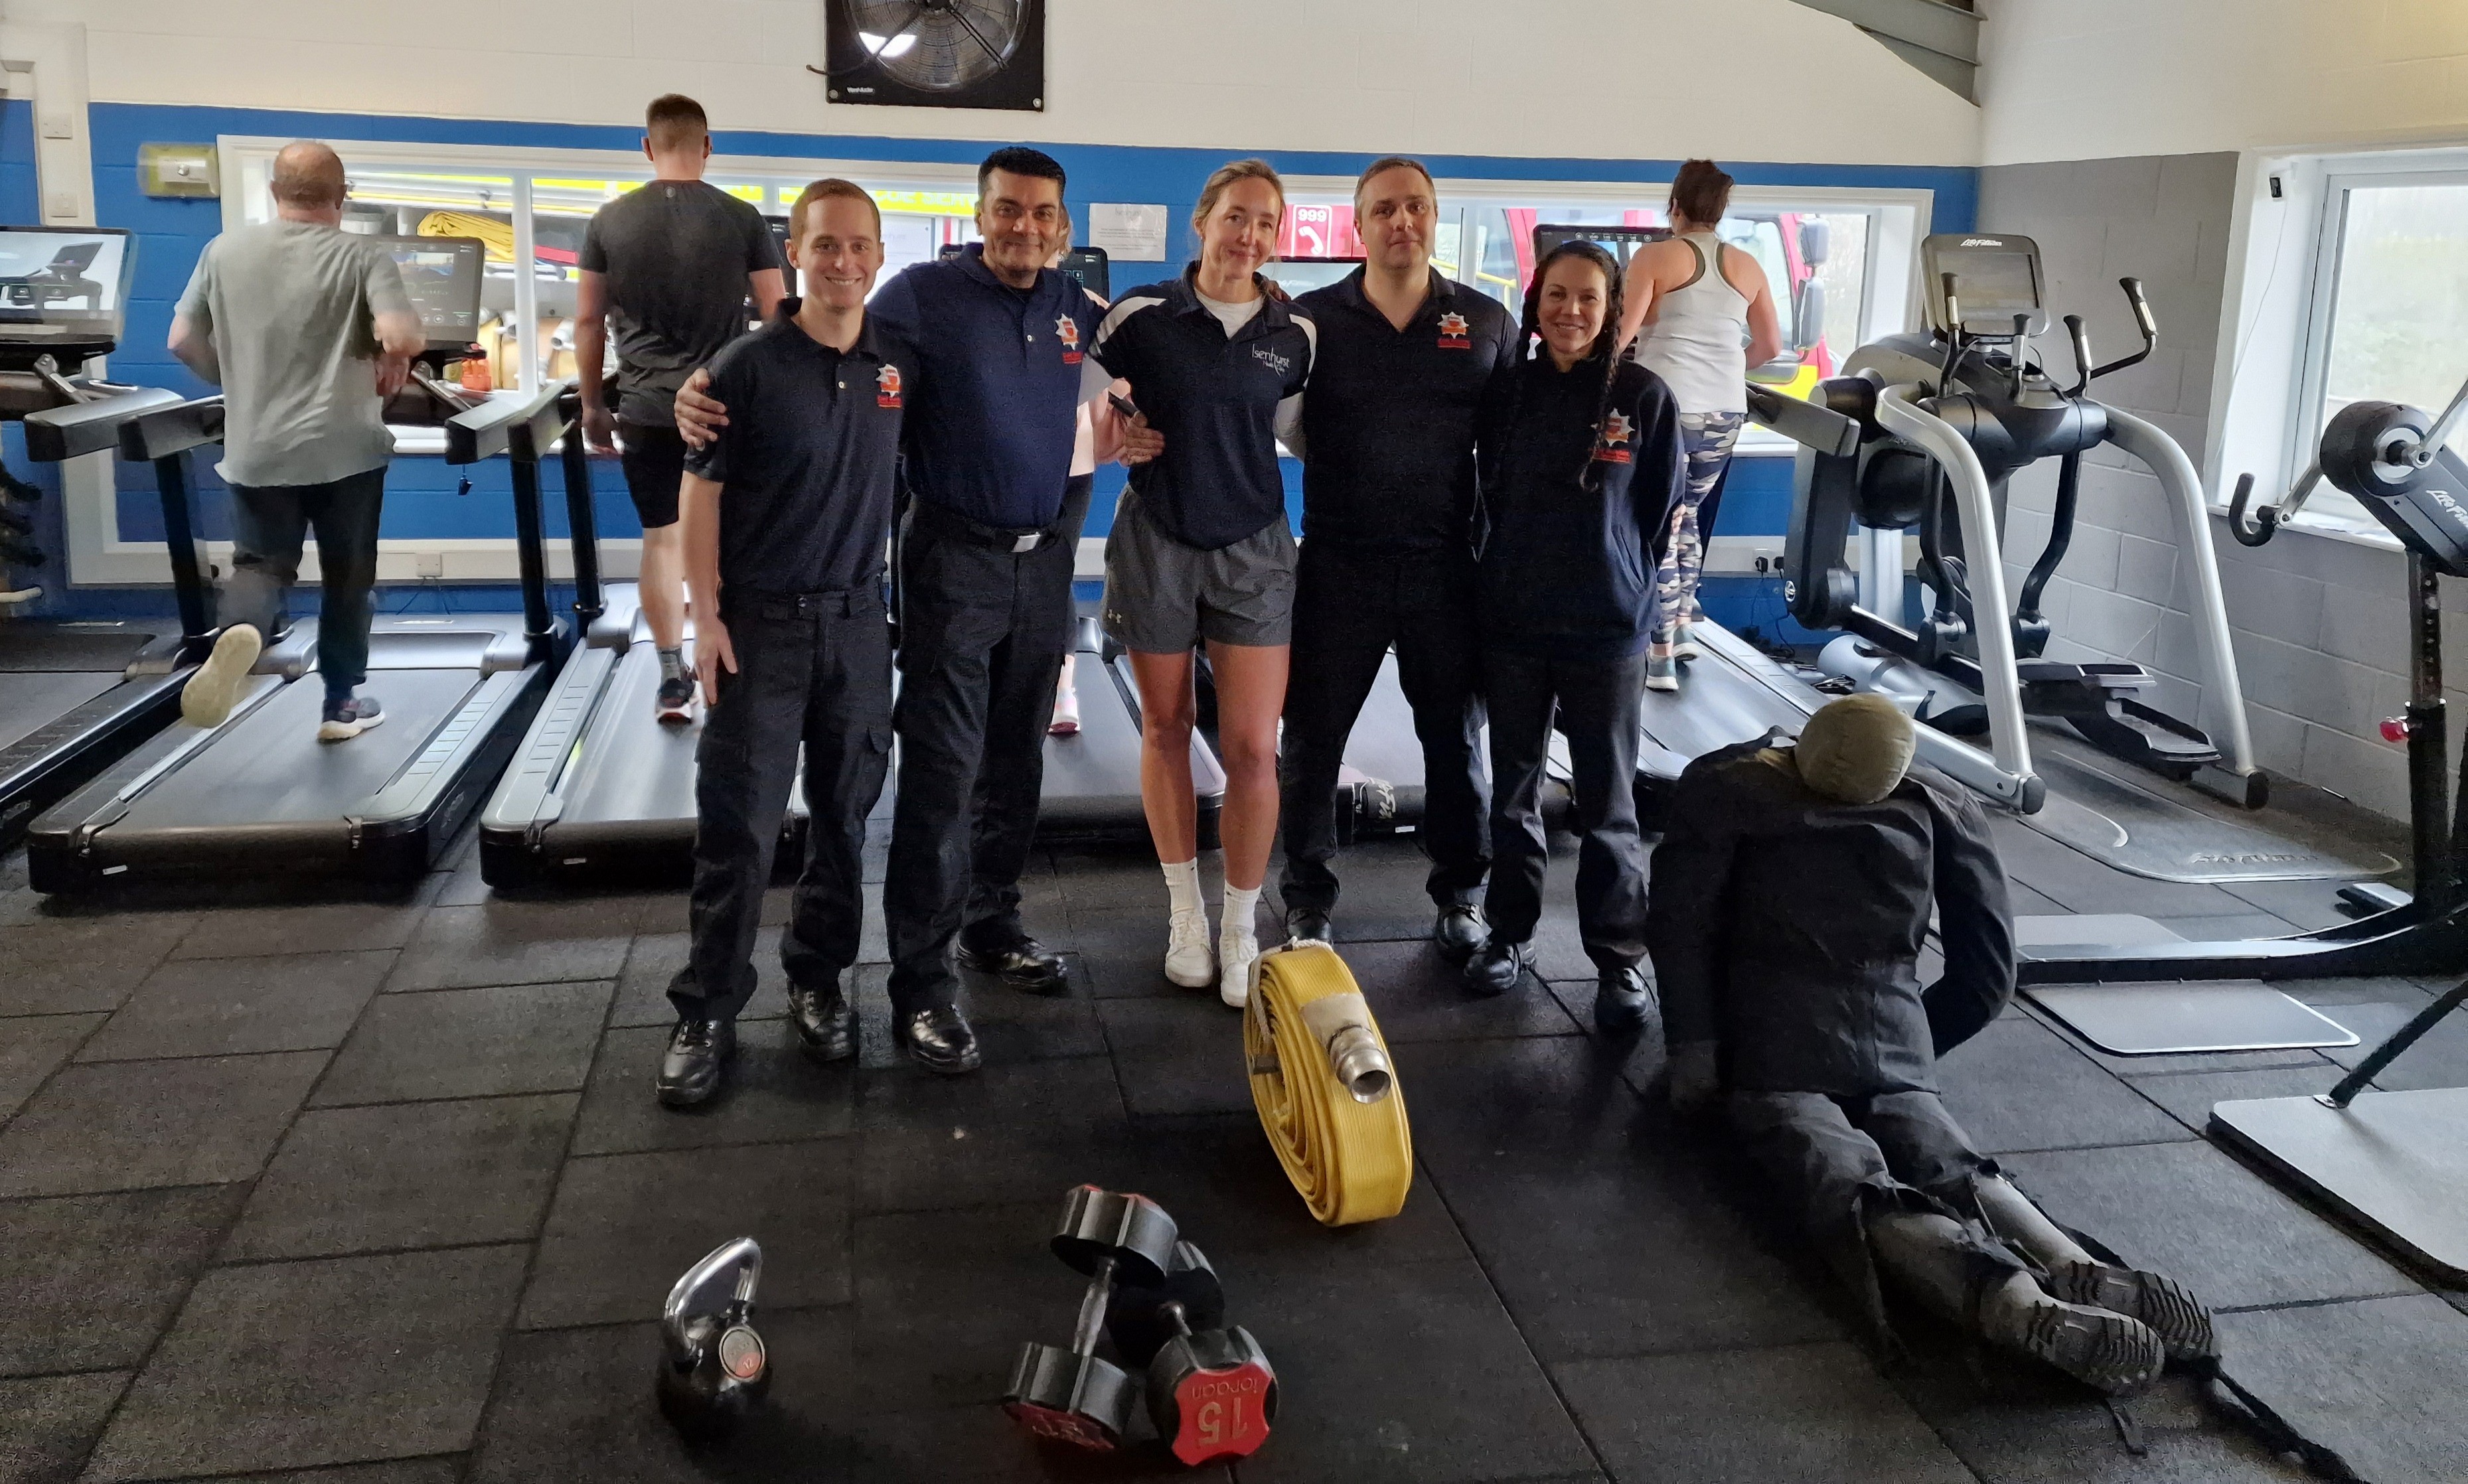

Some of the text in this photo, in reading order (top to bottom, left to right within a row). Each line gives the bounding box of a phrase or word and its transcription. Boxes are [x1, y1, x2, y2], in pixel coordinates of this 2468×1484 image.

[1298, 208, 1327, 222] 999
[1252, 343, 1290, 378] Isenhurst
[1198, 1397, 1248, 1444] 15
